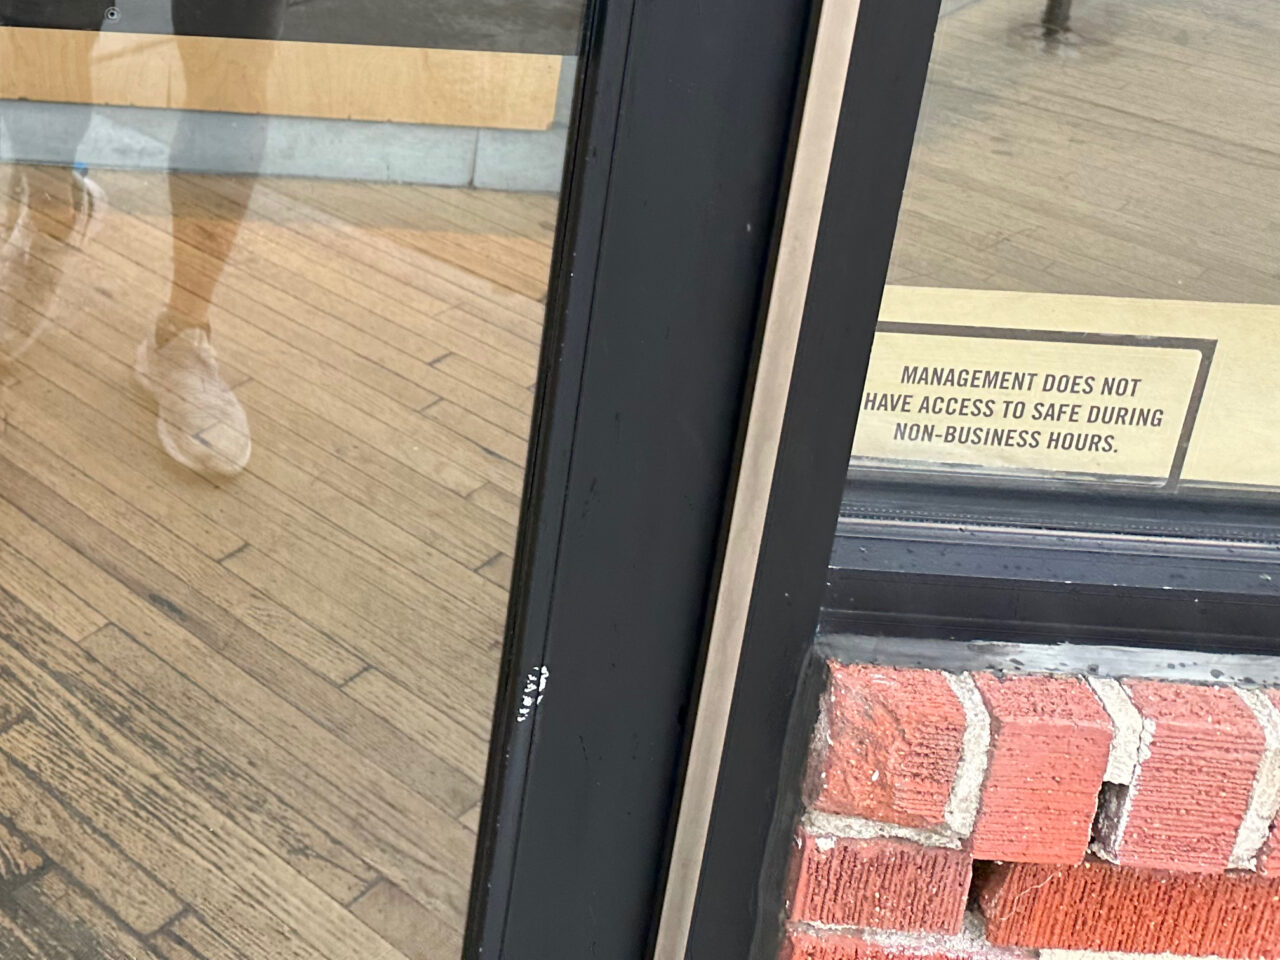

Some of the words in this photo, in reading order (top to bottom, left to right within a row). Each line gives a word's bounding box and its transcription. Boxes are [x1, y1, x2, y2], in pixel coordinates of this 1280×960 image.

[900, 365, 1039, 392] MANAGEMENT
[1041, 373, 1096, 395] DOES
[1099, 376, 1143, 398] NOT
[863, 392, 914, 413] HAVE
[917, 395, 996, 418] ACCESS
[1002, 400, 1026, 420] TO
[1030, 402, 1082, 423] SAFE
[1085, 405, 1165, 428] DURING
[893, 422, 1042, 449] NON-BUSINESS
[1045, 431, 1120, 454] HOURS.
